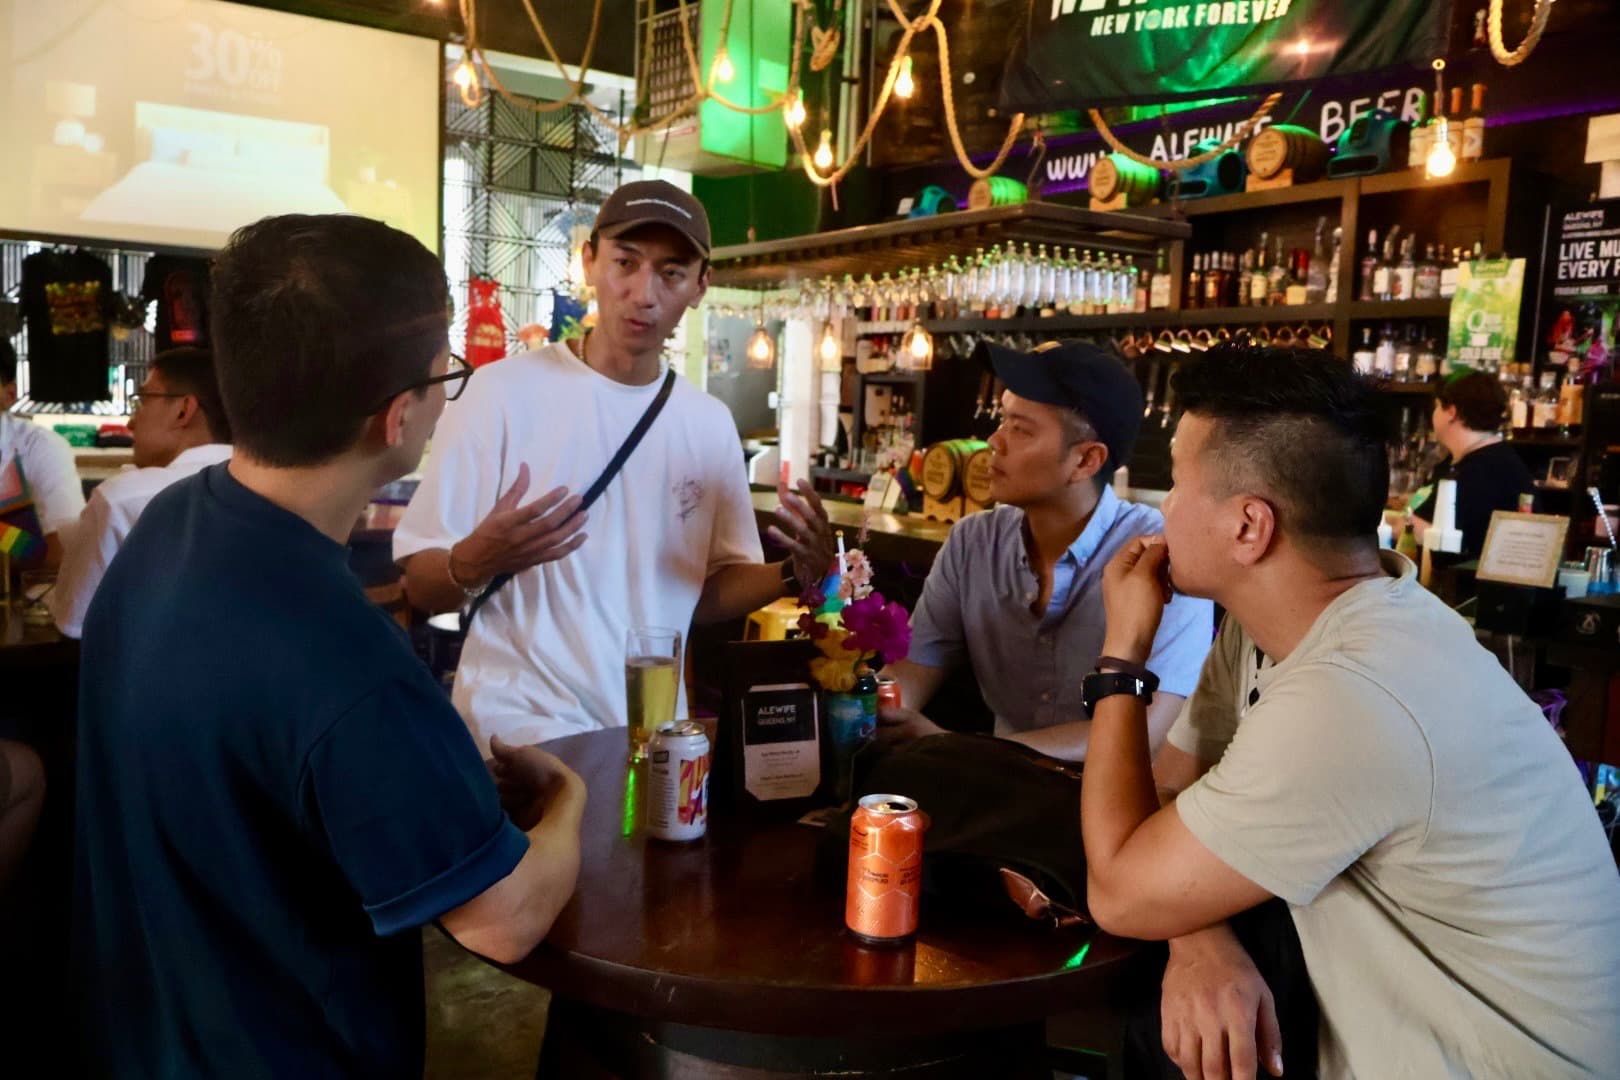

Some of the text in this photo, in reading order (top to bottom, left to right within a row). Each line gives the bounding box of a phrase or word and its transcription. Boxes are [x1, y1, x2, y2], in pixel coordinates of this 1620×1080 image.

[1091, 12, 1131, 37] NEW
[1134, 5, 1191, 32] YORK
[1194, 0, 1292, 27] FOREVER
[1559, 241, 1596, 261] LIVE
[1557, 259, 1610, 280] EVERY
[758, 704, 798, 716] ALEWIFE
